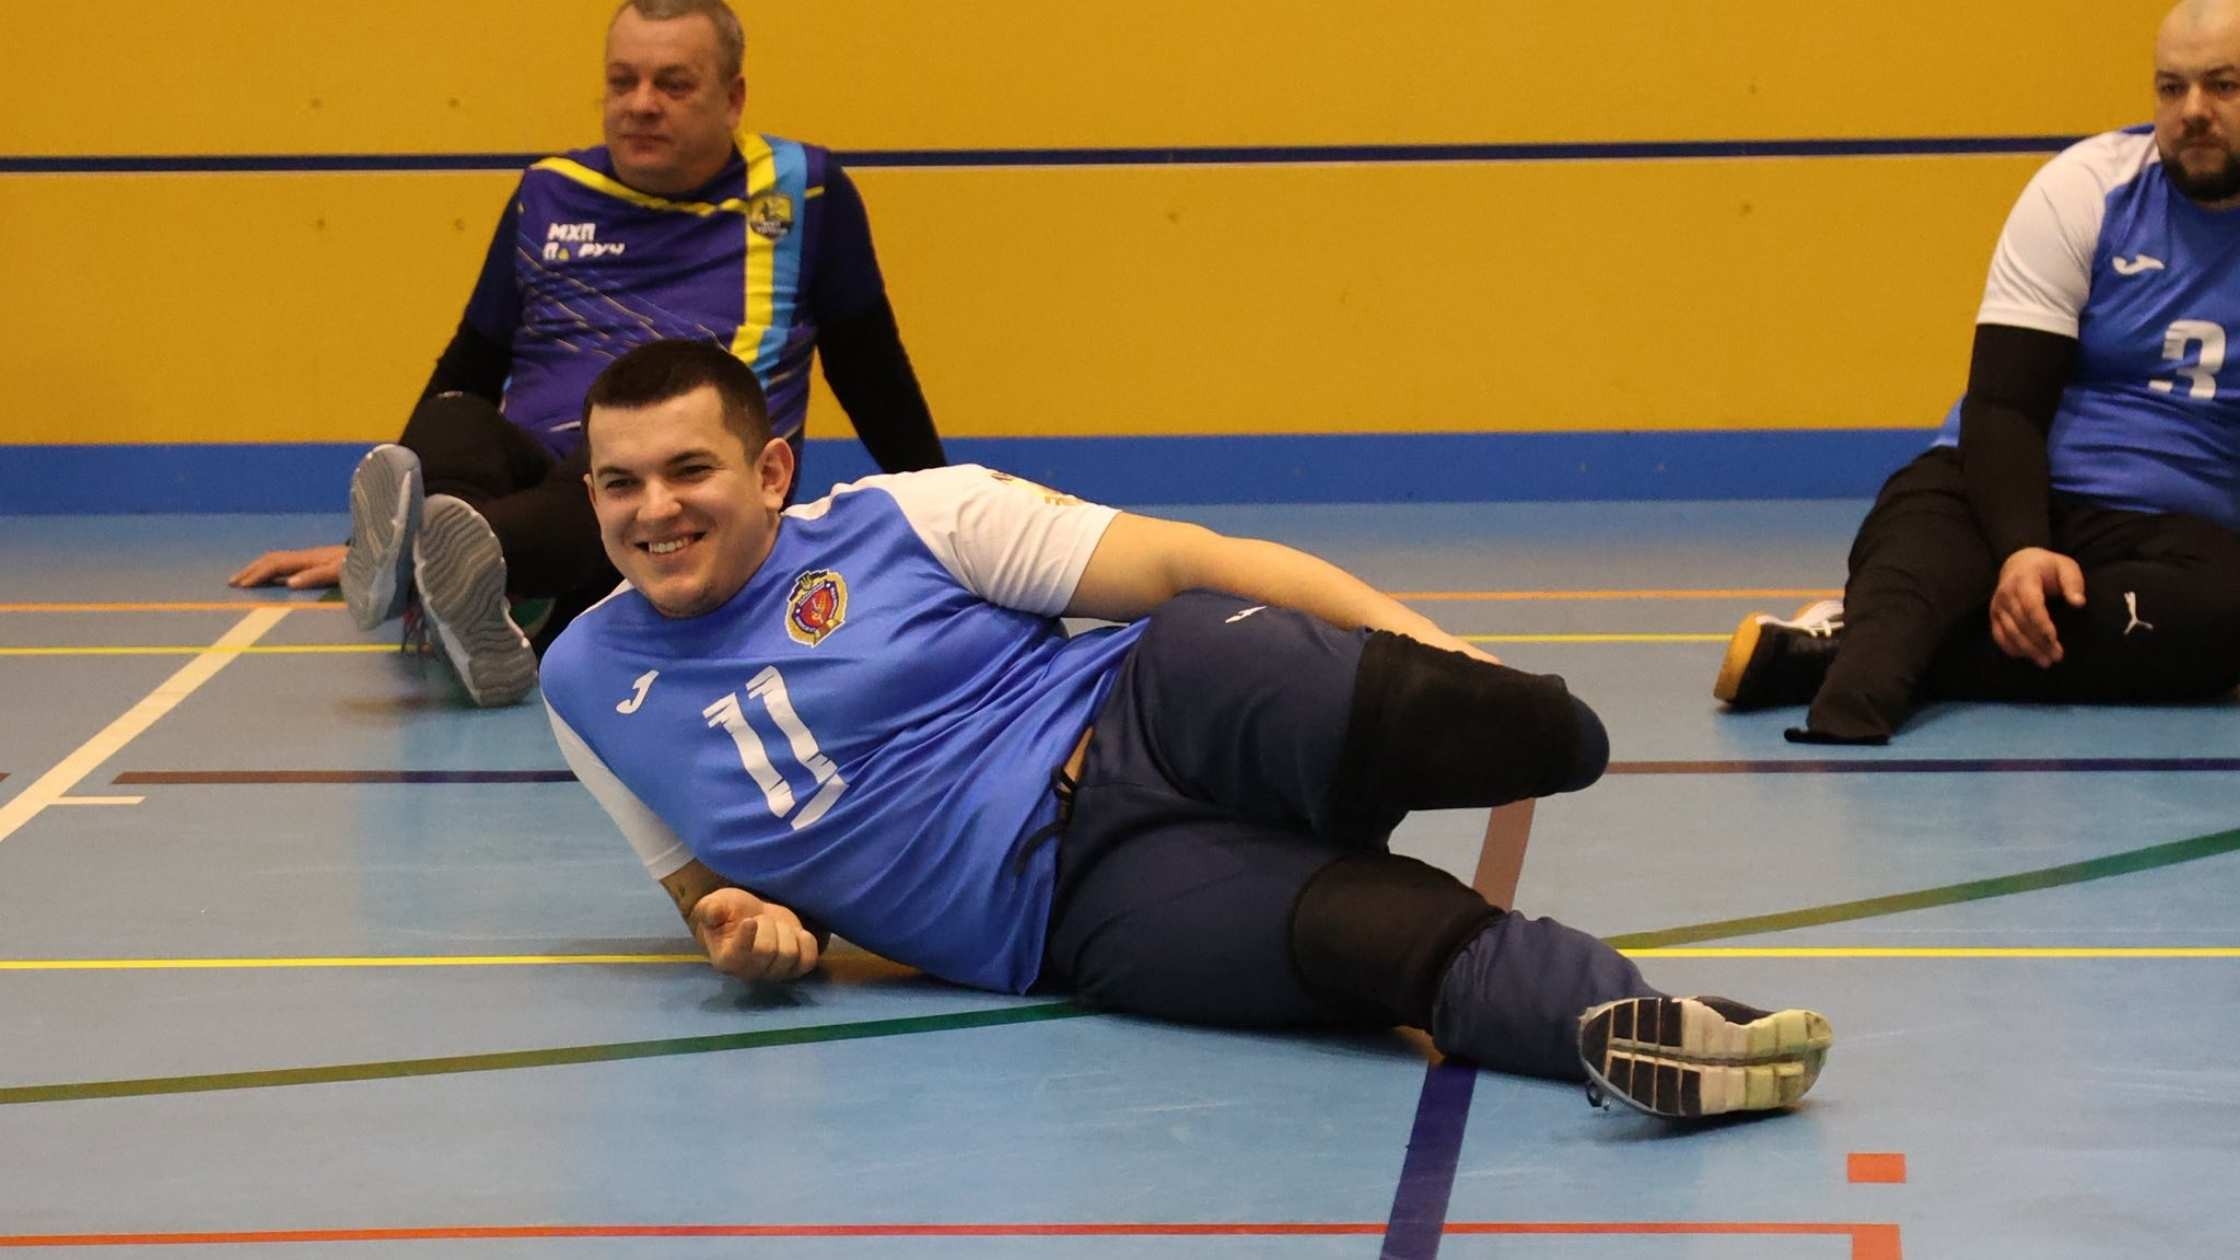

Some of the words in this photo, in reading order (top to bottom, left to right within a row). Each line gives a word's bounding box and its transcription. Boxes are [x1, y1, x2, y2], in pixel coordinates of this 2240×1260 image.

[547, 222, 597, 241] МХП
[2149, 319, 2227, 401] 3
[701, 664, 850, 832] 11
